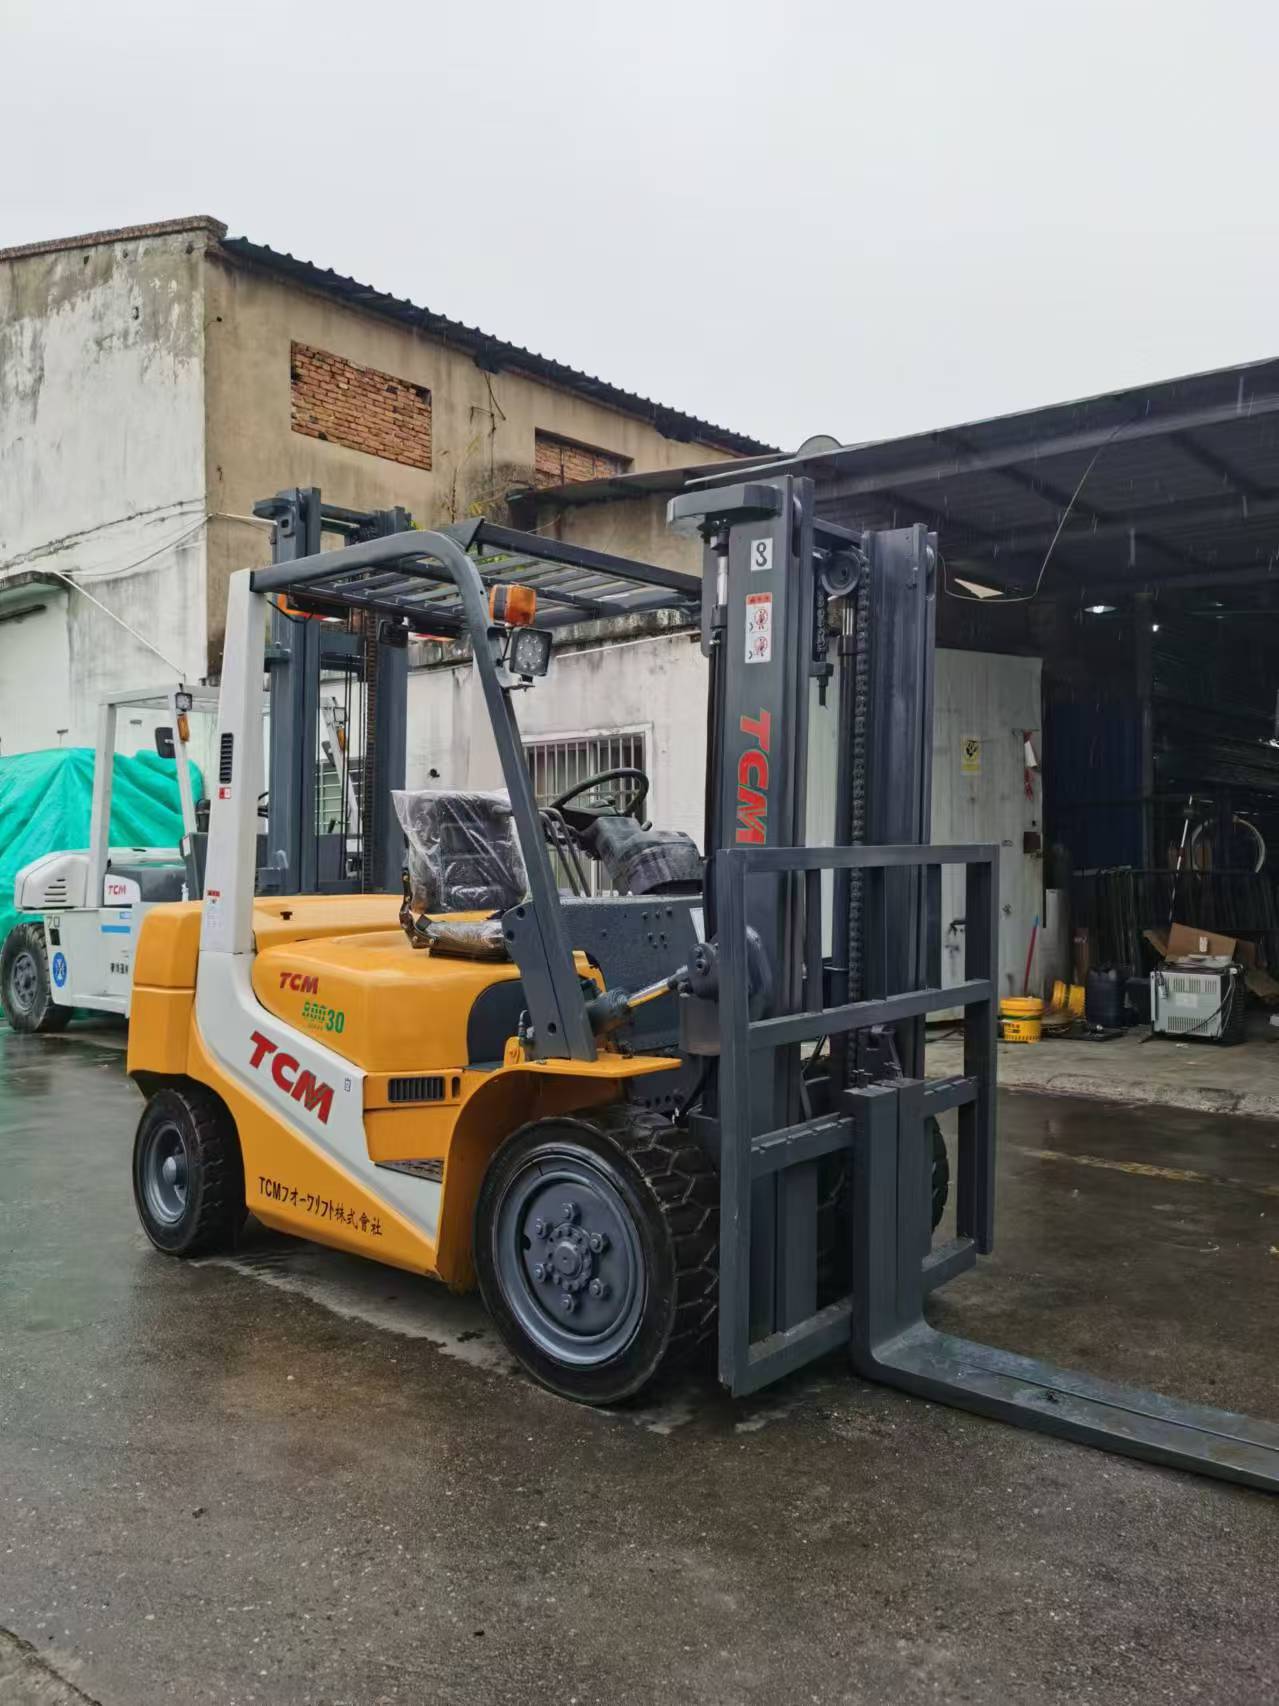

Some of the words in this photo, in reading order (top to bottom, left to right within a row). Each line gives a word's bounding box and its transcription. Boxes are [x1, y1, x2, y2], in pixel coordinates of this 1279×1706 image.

[736, 708, 770, 844] TCM
[107, 885, 127, 895] TCM
[279, 972, 319, 995] TCM
[249, 1030, 335, 1125] TCM
